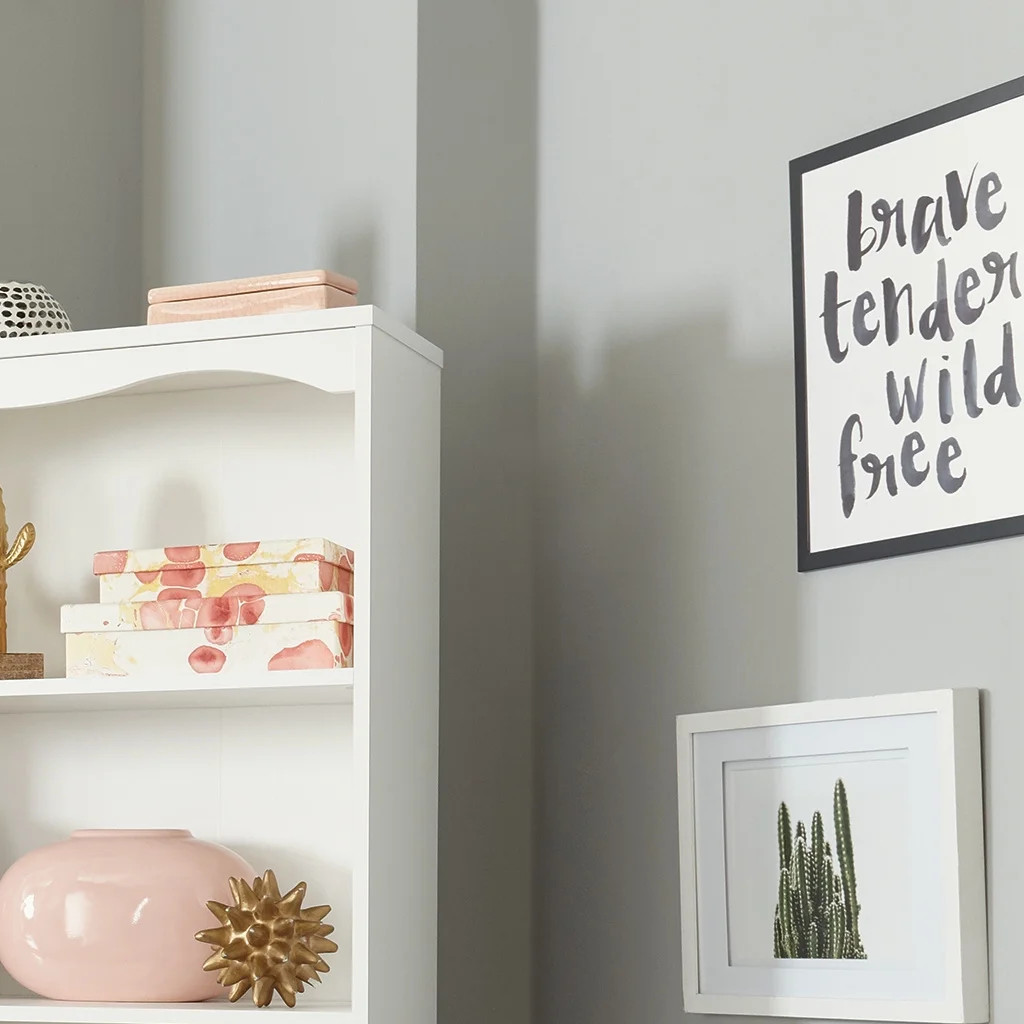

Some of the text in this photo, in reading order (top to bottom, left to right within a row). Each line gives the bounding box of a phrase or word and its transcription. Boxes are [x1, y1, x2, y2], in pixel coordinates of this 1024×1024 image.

[846, 161, 1007, 272] brave
[820, 250, 1023, 364] tender
[886, 321, 1023, 424] wild
[837, 412, 967, 519] free
